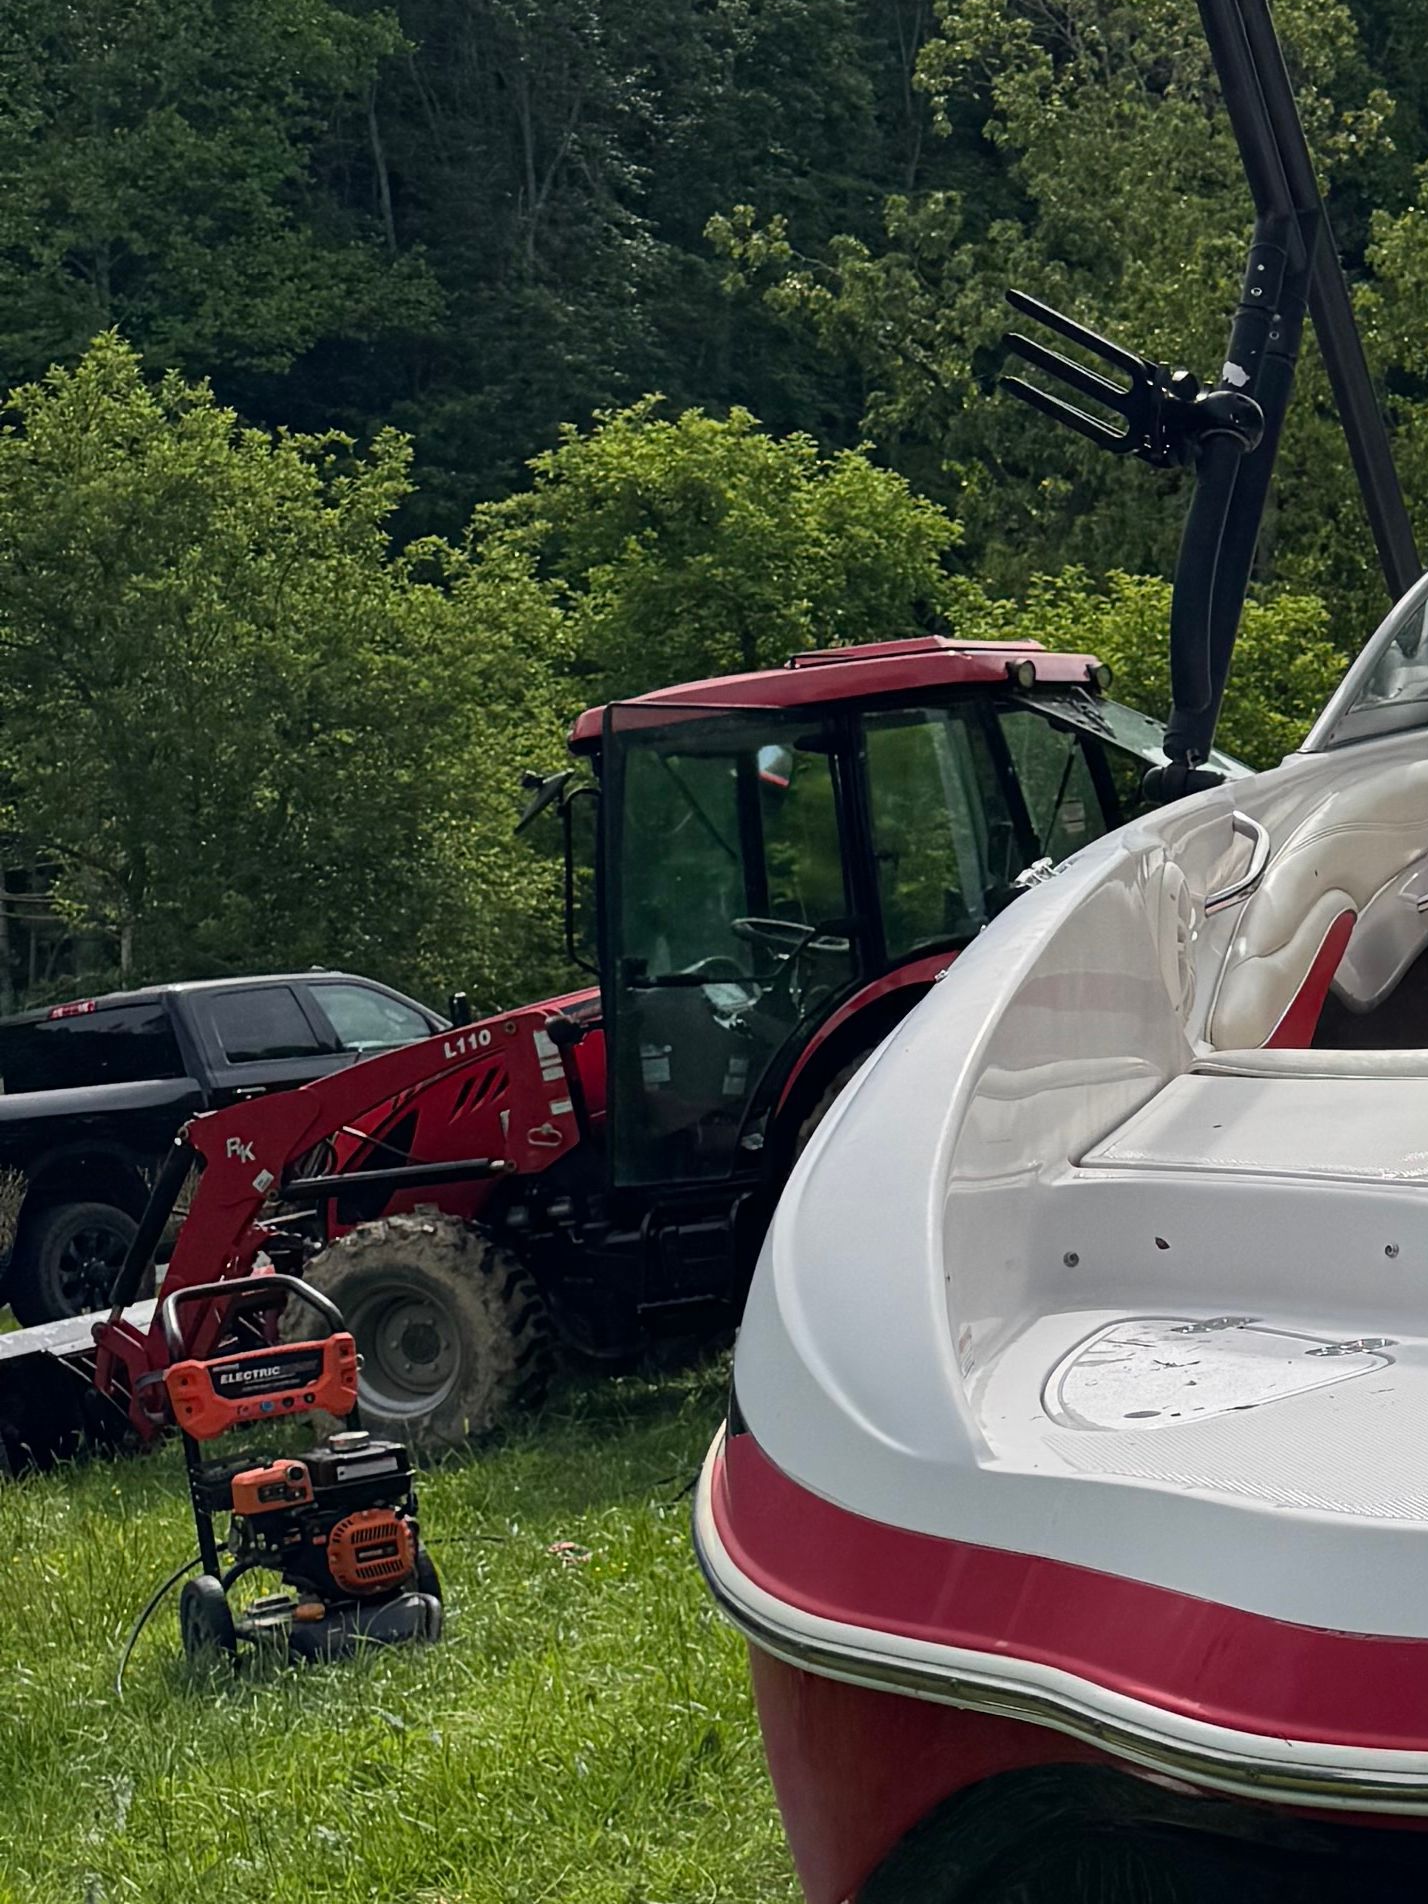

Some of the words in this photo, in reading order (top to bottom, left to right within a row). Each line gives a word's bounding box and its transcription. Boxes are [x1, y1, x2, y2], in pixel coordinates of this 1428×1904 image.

[444, 1029, 491, 1059] L110
[226, 1137, 256, 1164] RK
[220, 1366, 280, 1385] ELECTRIC
